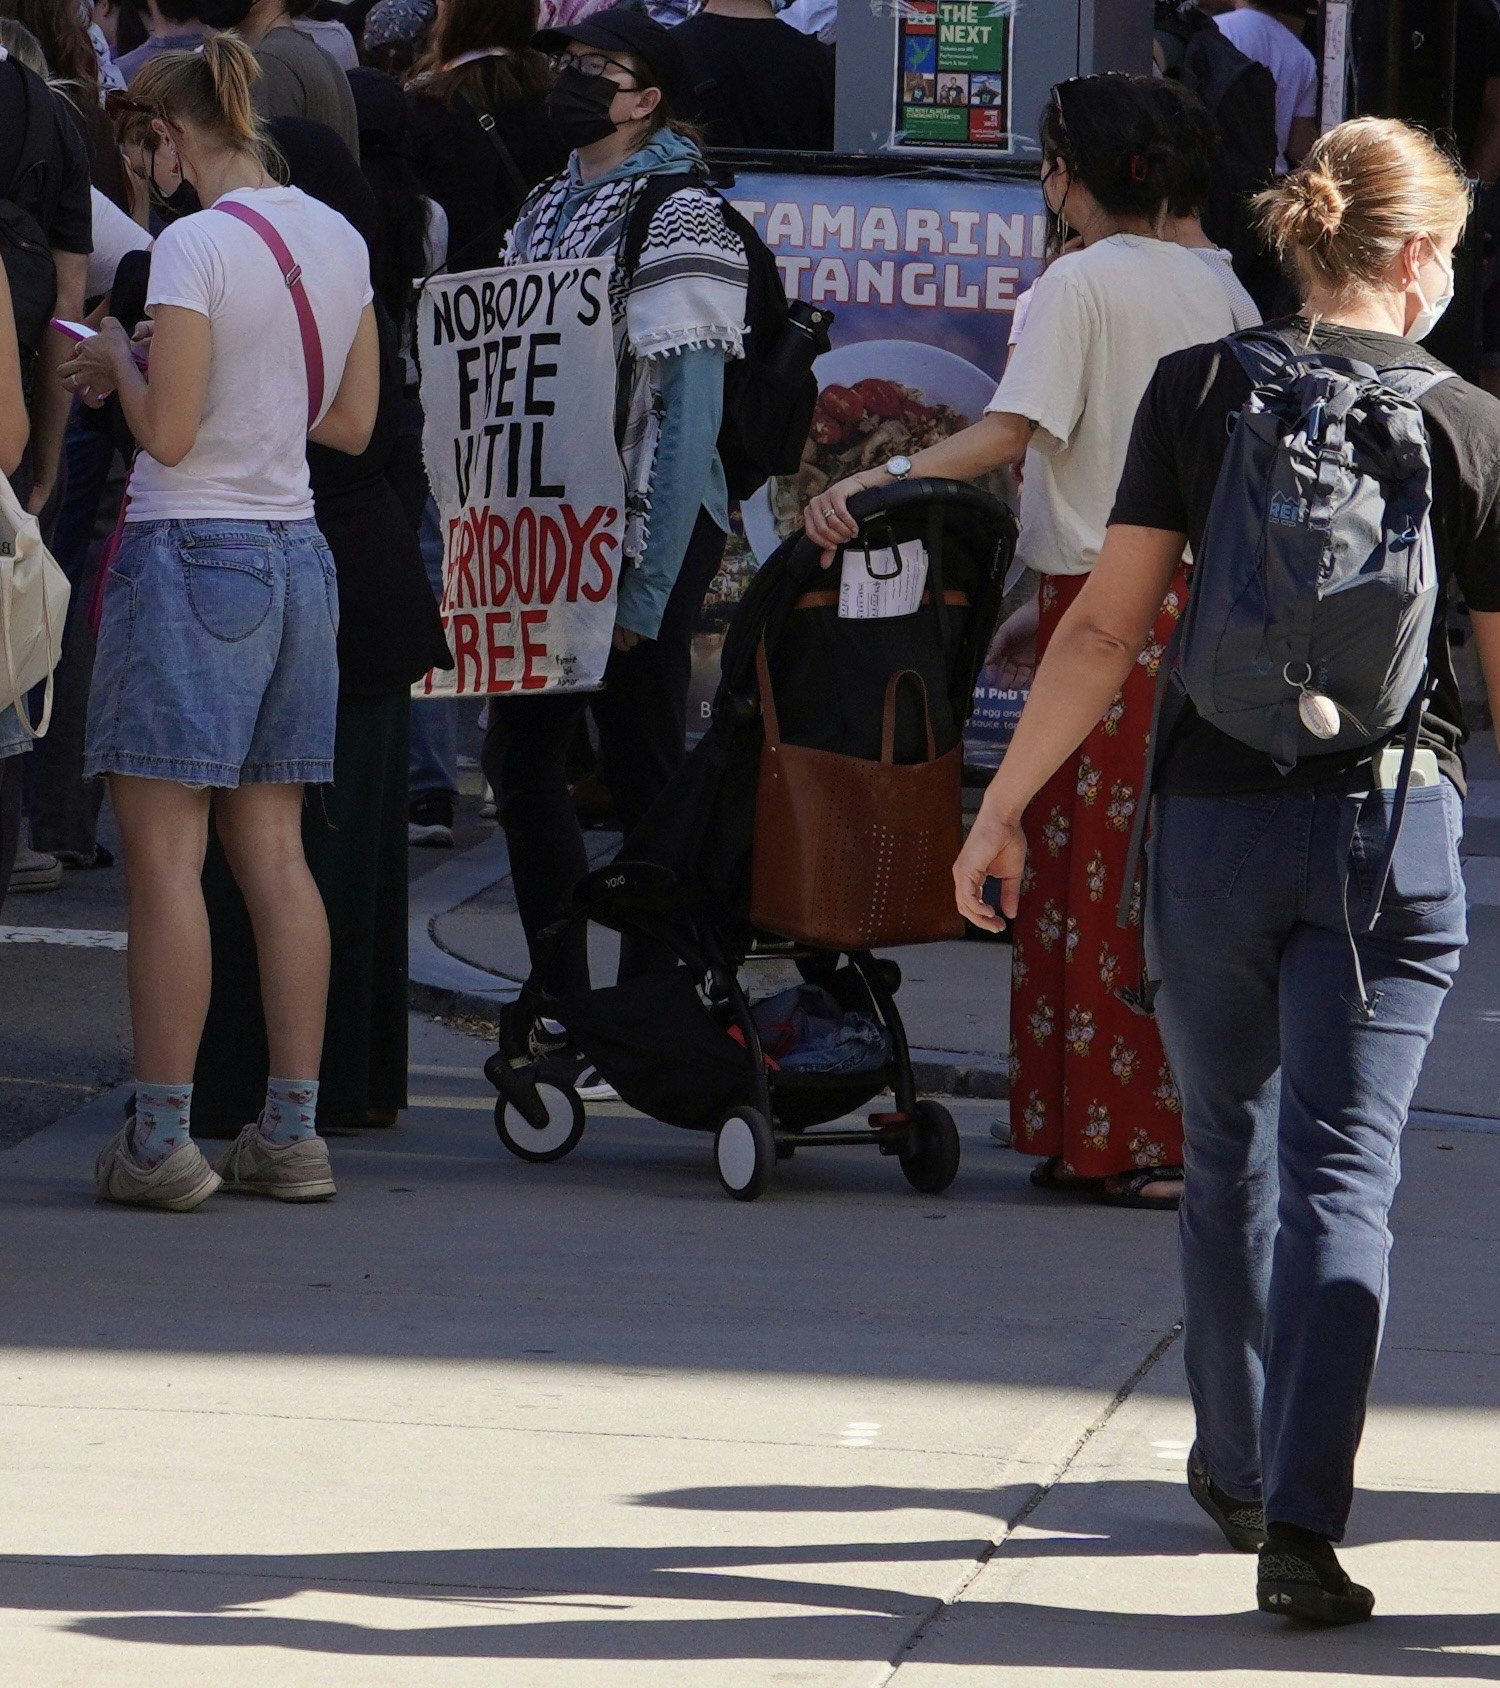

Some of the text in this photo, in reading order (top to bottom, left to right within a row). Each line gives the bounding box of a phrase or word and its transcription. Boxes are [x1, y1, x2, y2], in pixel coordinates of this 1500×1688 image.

[941, 4, 978, 23] THE
[940, 25, 992, 44] NEXT
[775, 255, 1021, 311] TANGLE
[434, 268, 602, 346] NOBODY'S
[988, 688, 1018, 701] PAD
